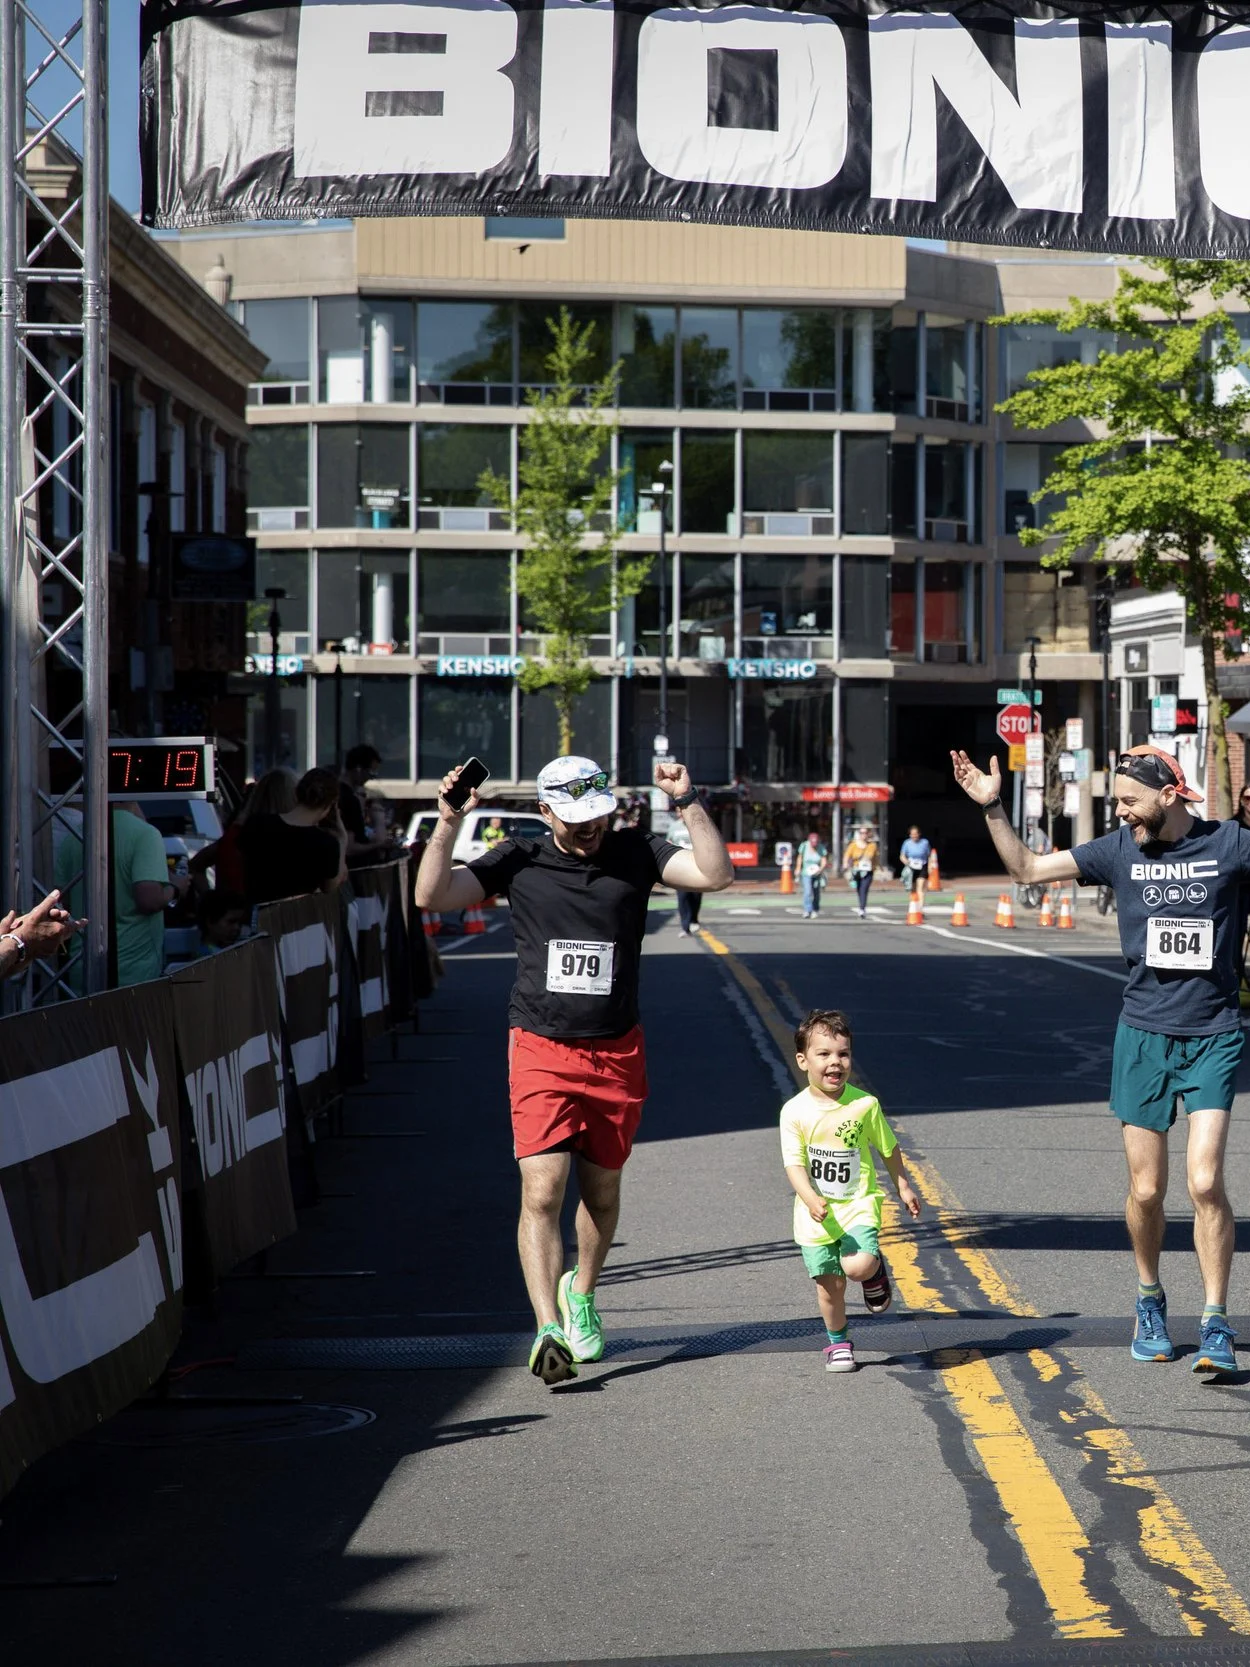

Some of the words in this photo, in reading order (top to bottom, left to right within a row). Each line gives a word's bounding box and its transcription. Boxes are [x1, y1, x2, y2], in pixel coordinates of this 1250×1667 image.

[728, 659, 816, 679] KENSHO
[1000, 715, 1038, 733] STOP
[1130, 859, 1219, 881] BIONIC
[1155, 919, 1198, 928] BIONIC
[556, 941, 600, 952] BIONIC
[1159, 931, 1201, 955] 864
[561, 953, 601, 978] 979
[184, 1032, 284, 1182] IONIC
[834, 1119, 852, 1138] EAST
[808, 1146, 849, 1158] BIONIC
[810, 1158, 851, 1184] 865
